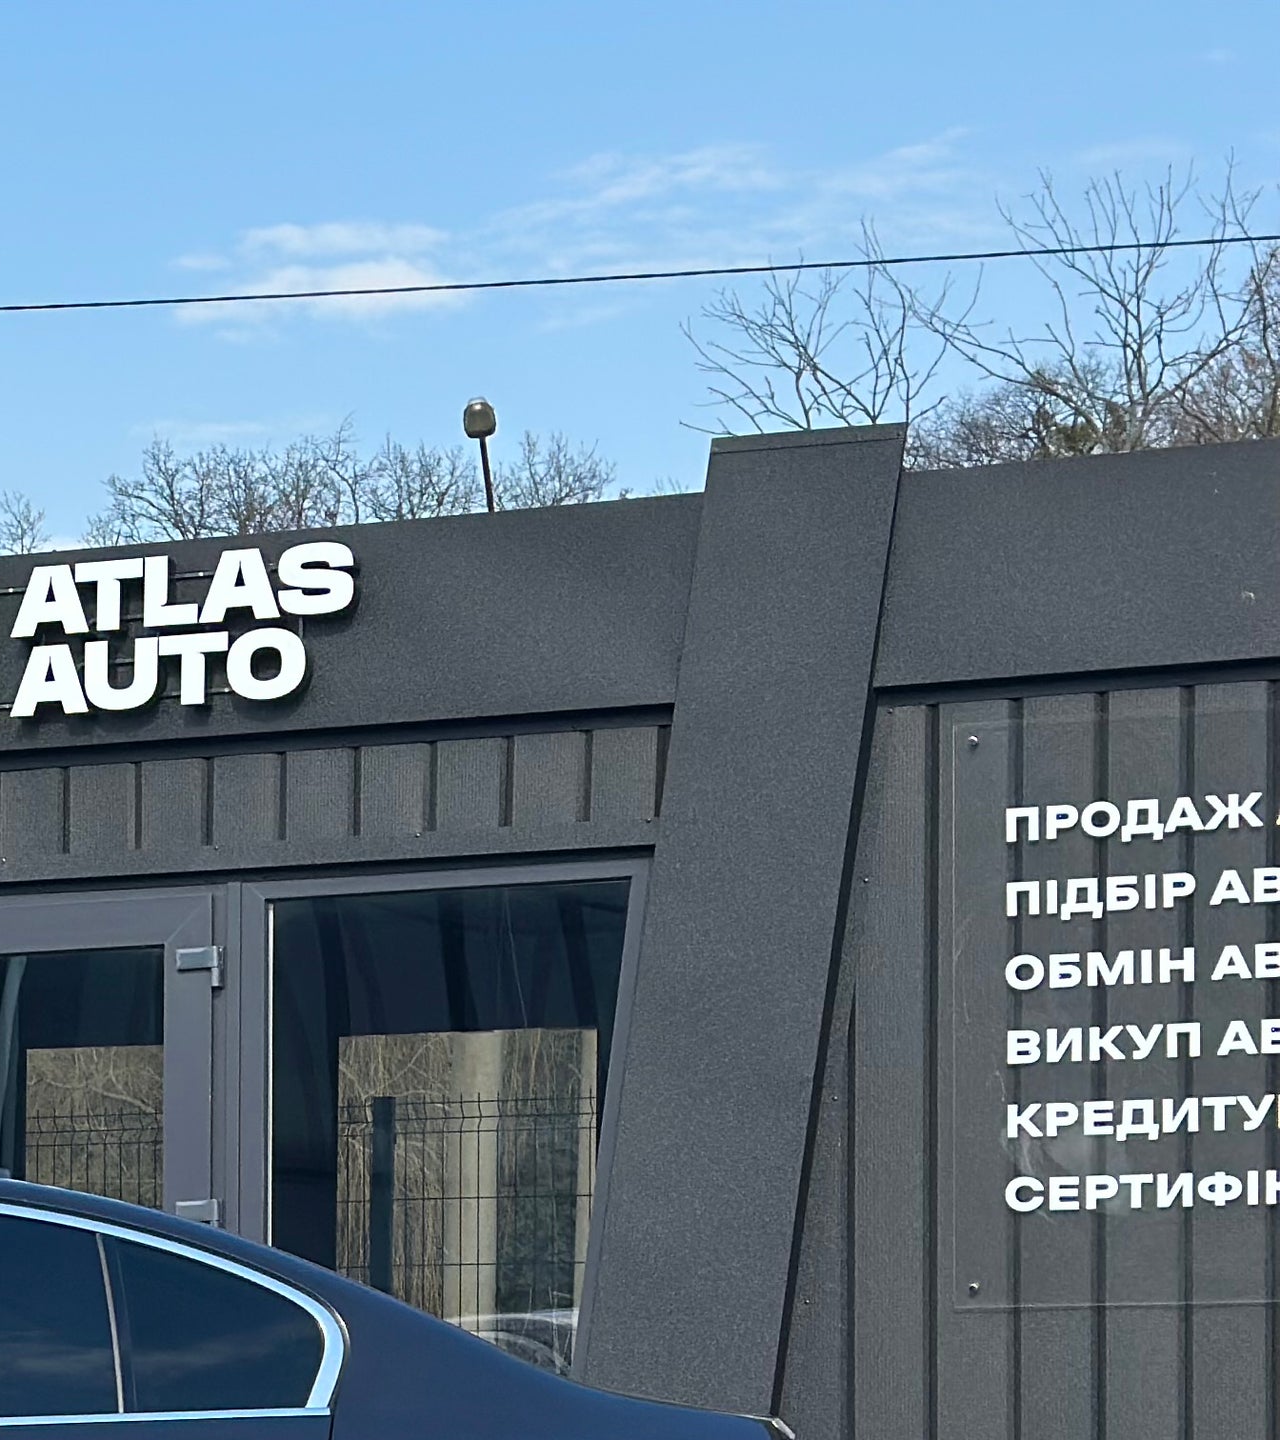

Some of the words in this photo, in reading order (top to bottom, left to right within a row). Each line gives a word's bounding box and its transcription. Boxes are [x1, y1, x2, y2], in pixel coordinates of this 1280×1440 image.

[10, 541, 354, 638] ATLAS
[10, 627, 307, 717] AUTO
[1005, 791, 1264, 843] ПРОДАЖ
[1006, 872, 1196, 921] ПІДБІР
[1005, 947, 1195, 990] ОБМІН
[1006, 1022, 1201, 1065] ВИКУП
[1007, 1093, 1280, 1142] КРЕДИТУ
